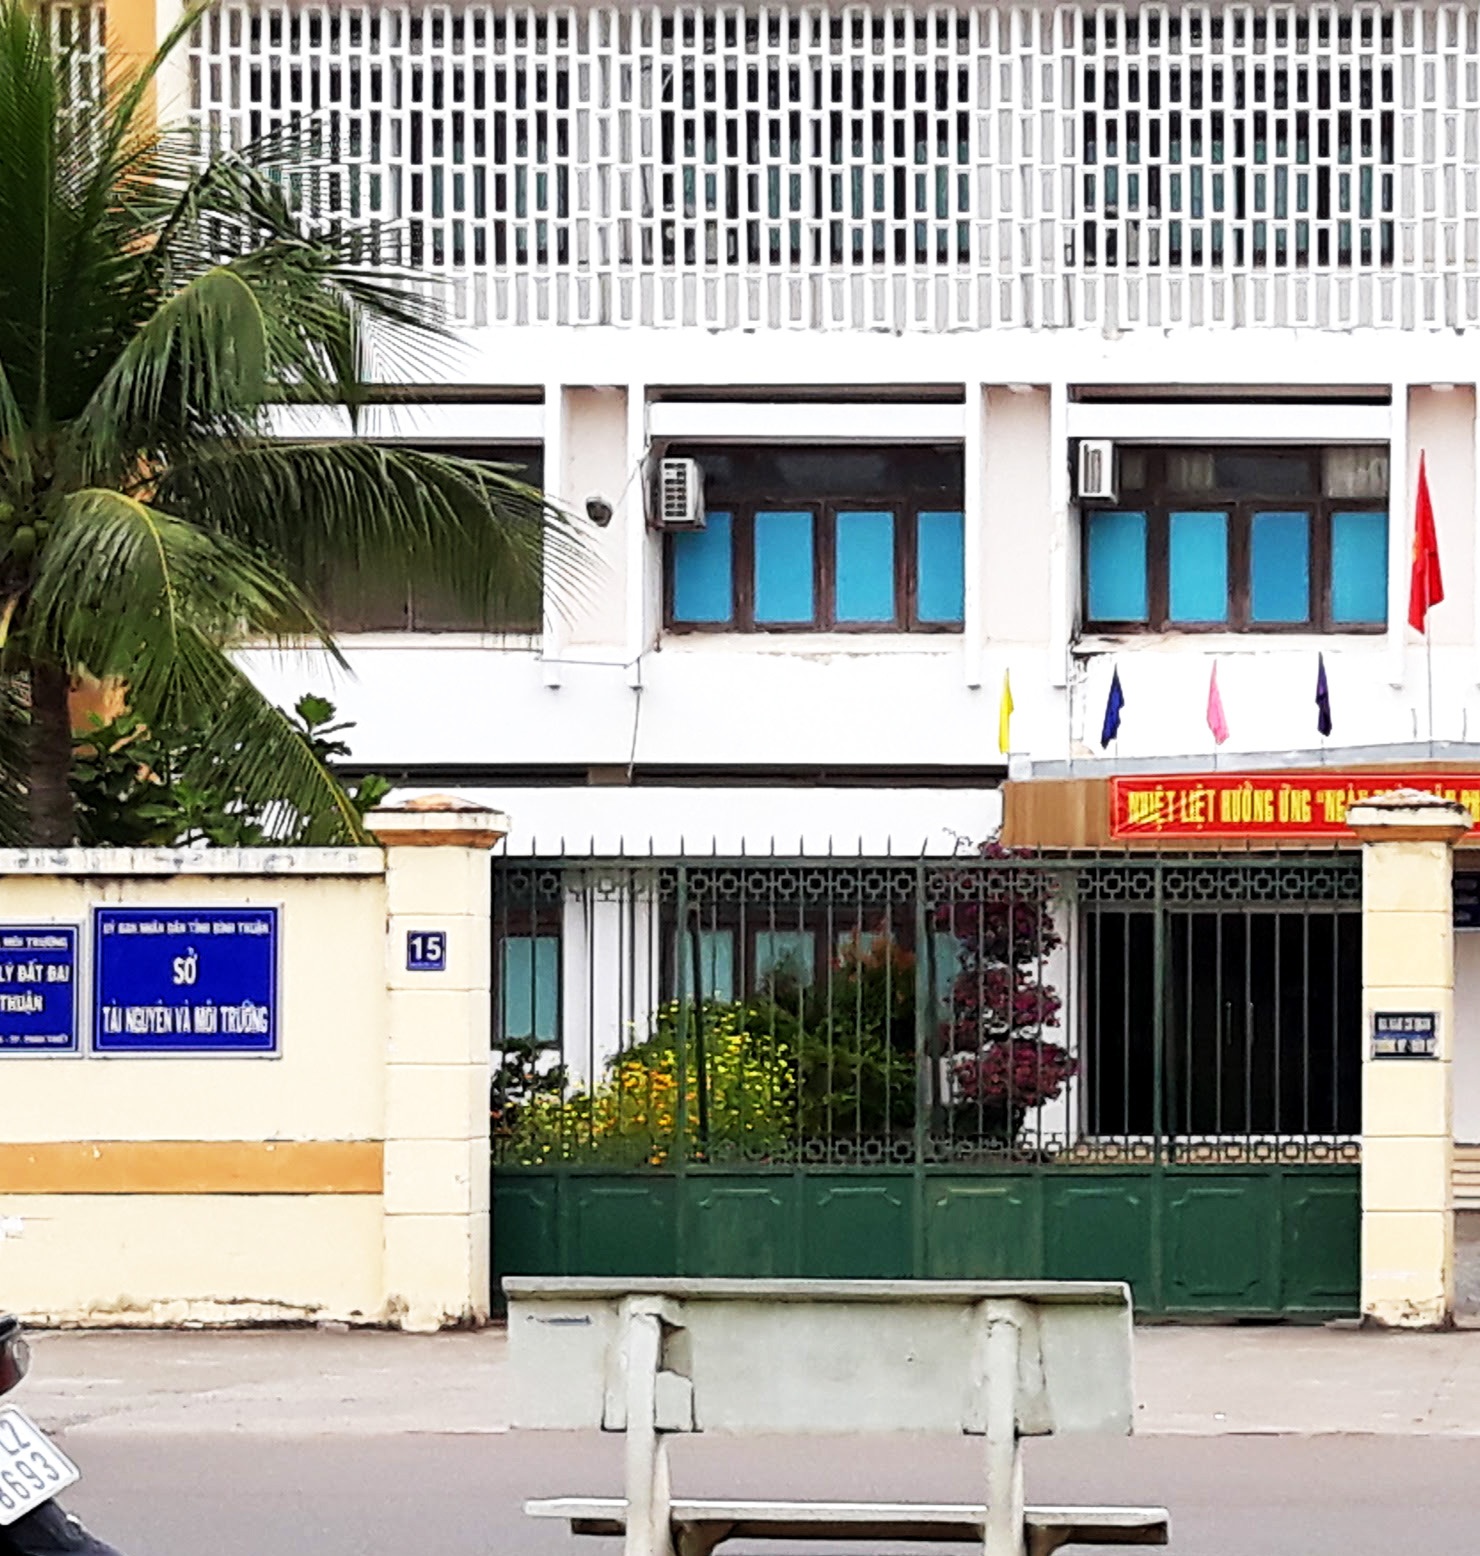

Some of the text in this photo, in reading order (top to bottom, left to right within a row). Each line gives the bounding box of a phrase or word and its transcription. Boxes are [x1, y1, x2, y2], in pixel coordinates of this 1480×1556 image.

[1180, 783, 1215, 829] LIỆT
[1221, 781, 1274, 822] HƯỞNG
[1279, 783, 1311, 822] ỨNG
[173, 947, 197, 985] SỞ
[411, 937, 441, 960] 15
[17, 959, 43, 981] ĐẤT
[47, 965, 69, 981] ĐAI
[102, 998, 268, 1033] TÀI NGUYÊN VÀ MÔI TRƯỜNG
